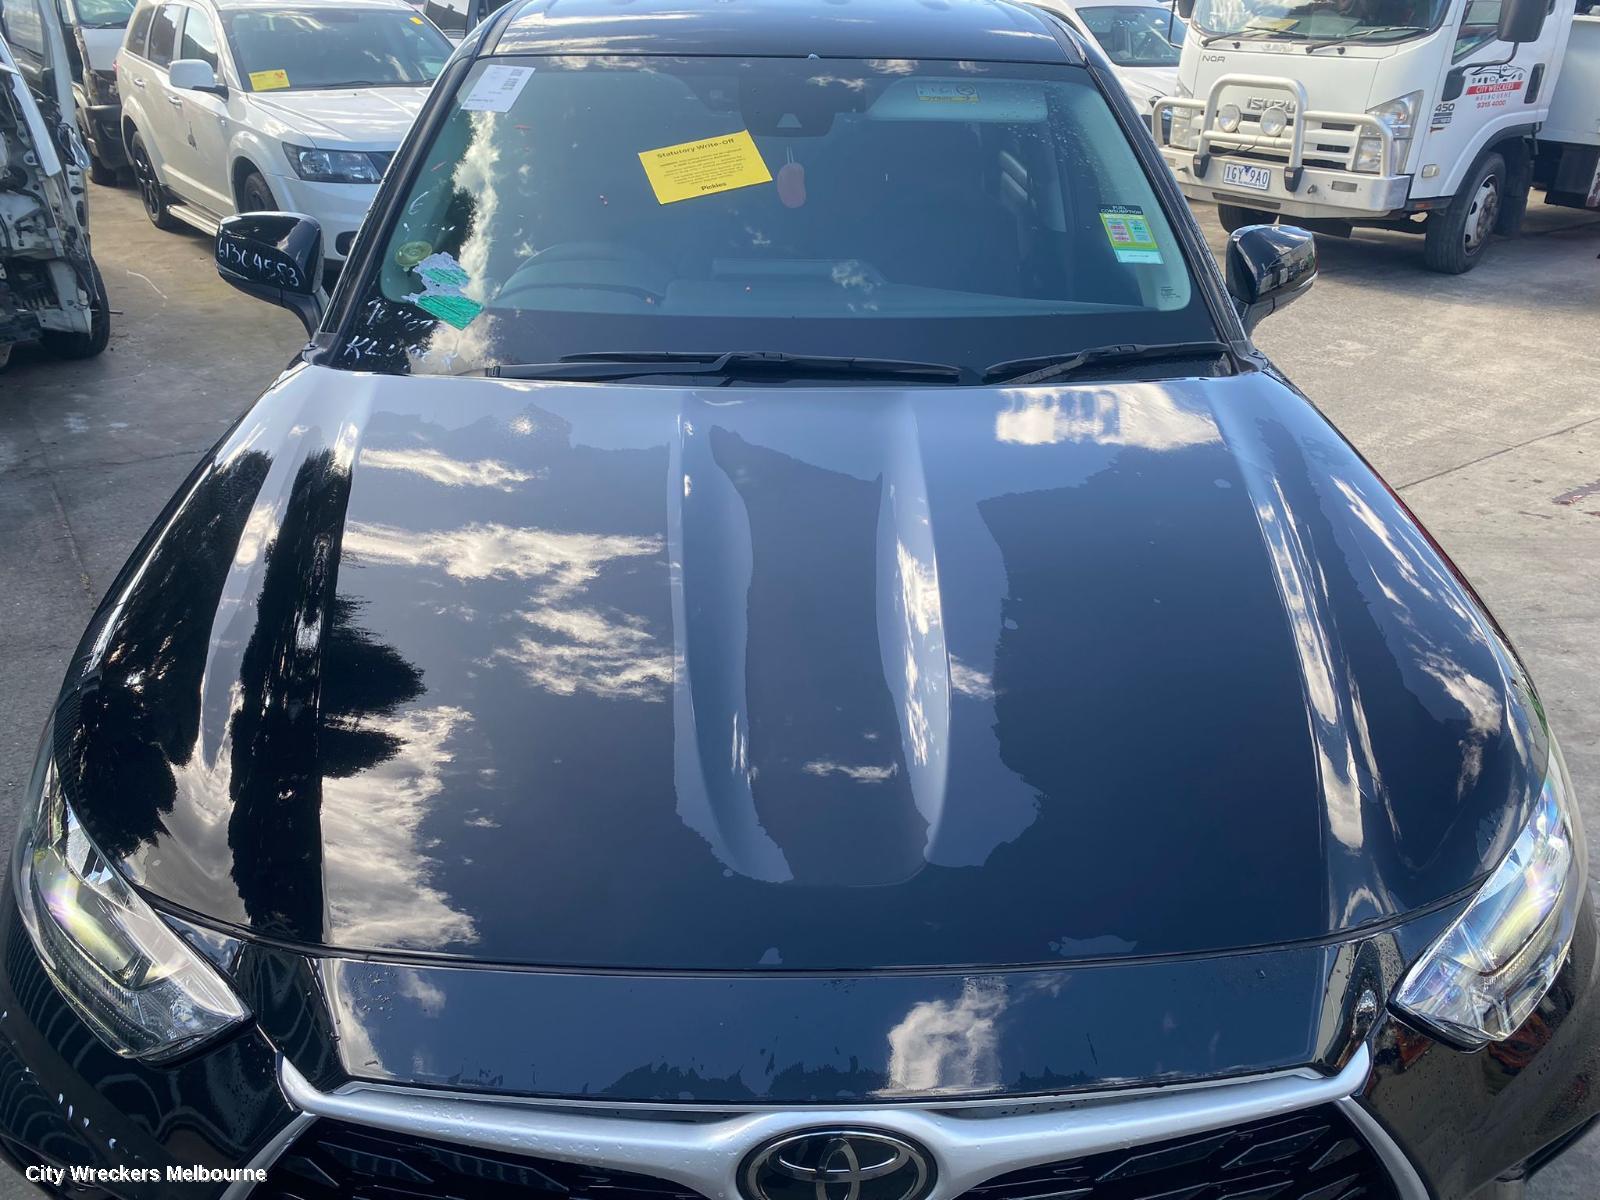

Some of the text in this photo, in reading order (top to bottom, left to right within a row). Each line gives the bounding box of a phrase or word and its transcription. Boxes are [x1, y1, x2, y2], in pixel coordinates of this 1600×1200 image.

[1476, 82, 1514, 94] CITY WRECKERS
[1435, 103, 1455, 112] 450
[657, 138, 734, 159] Statutory Write-Off
[701, 181, 728, 191] Pickles
